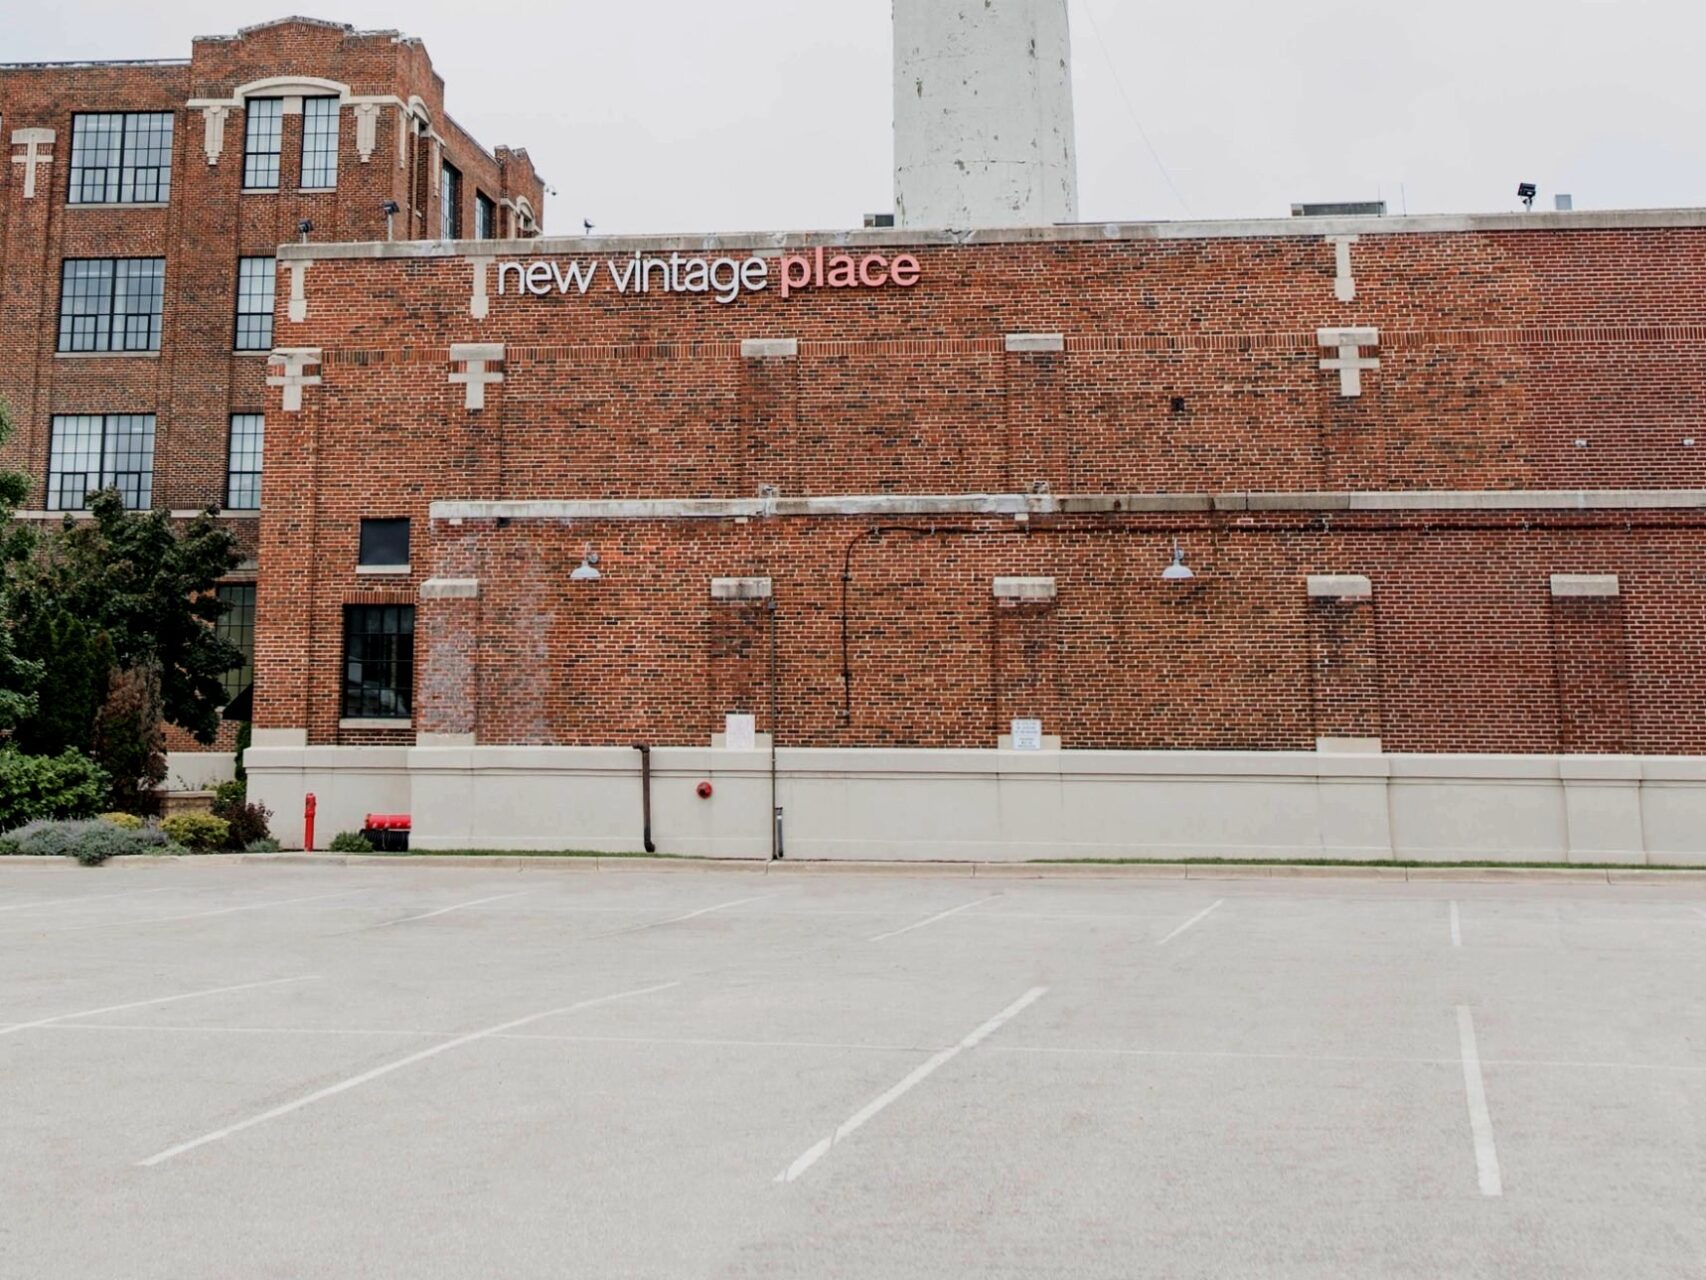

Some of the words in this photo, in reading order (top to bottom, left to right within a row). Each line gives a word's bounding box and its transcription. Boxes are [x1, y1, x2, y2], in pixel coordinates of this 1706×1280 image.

[499, 261, 597, 295] new
[608, 250, 767, 303] vintage
[781, 246, 920, 297] place
